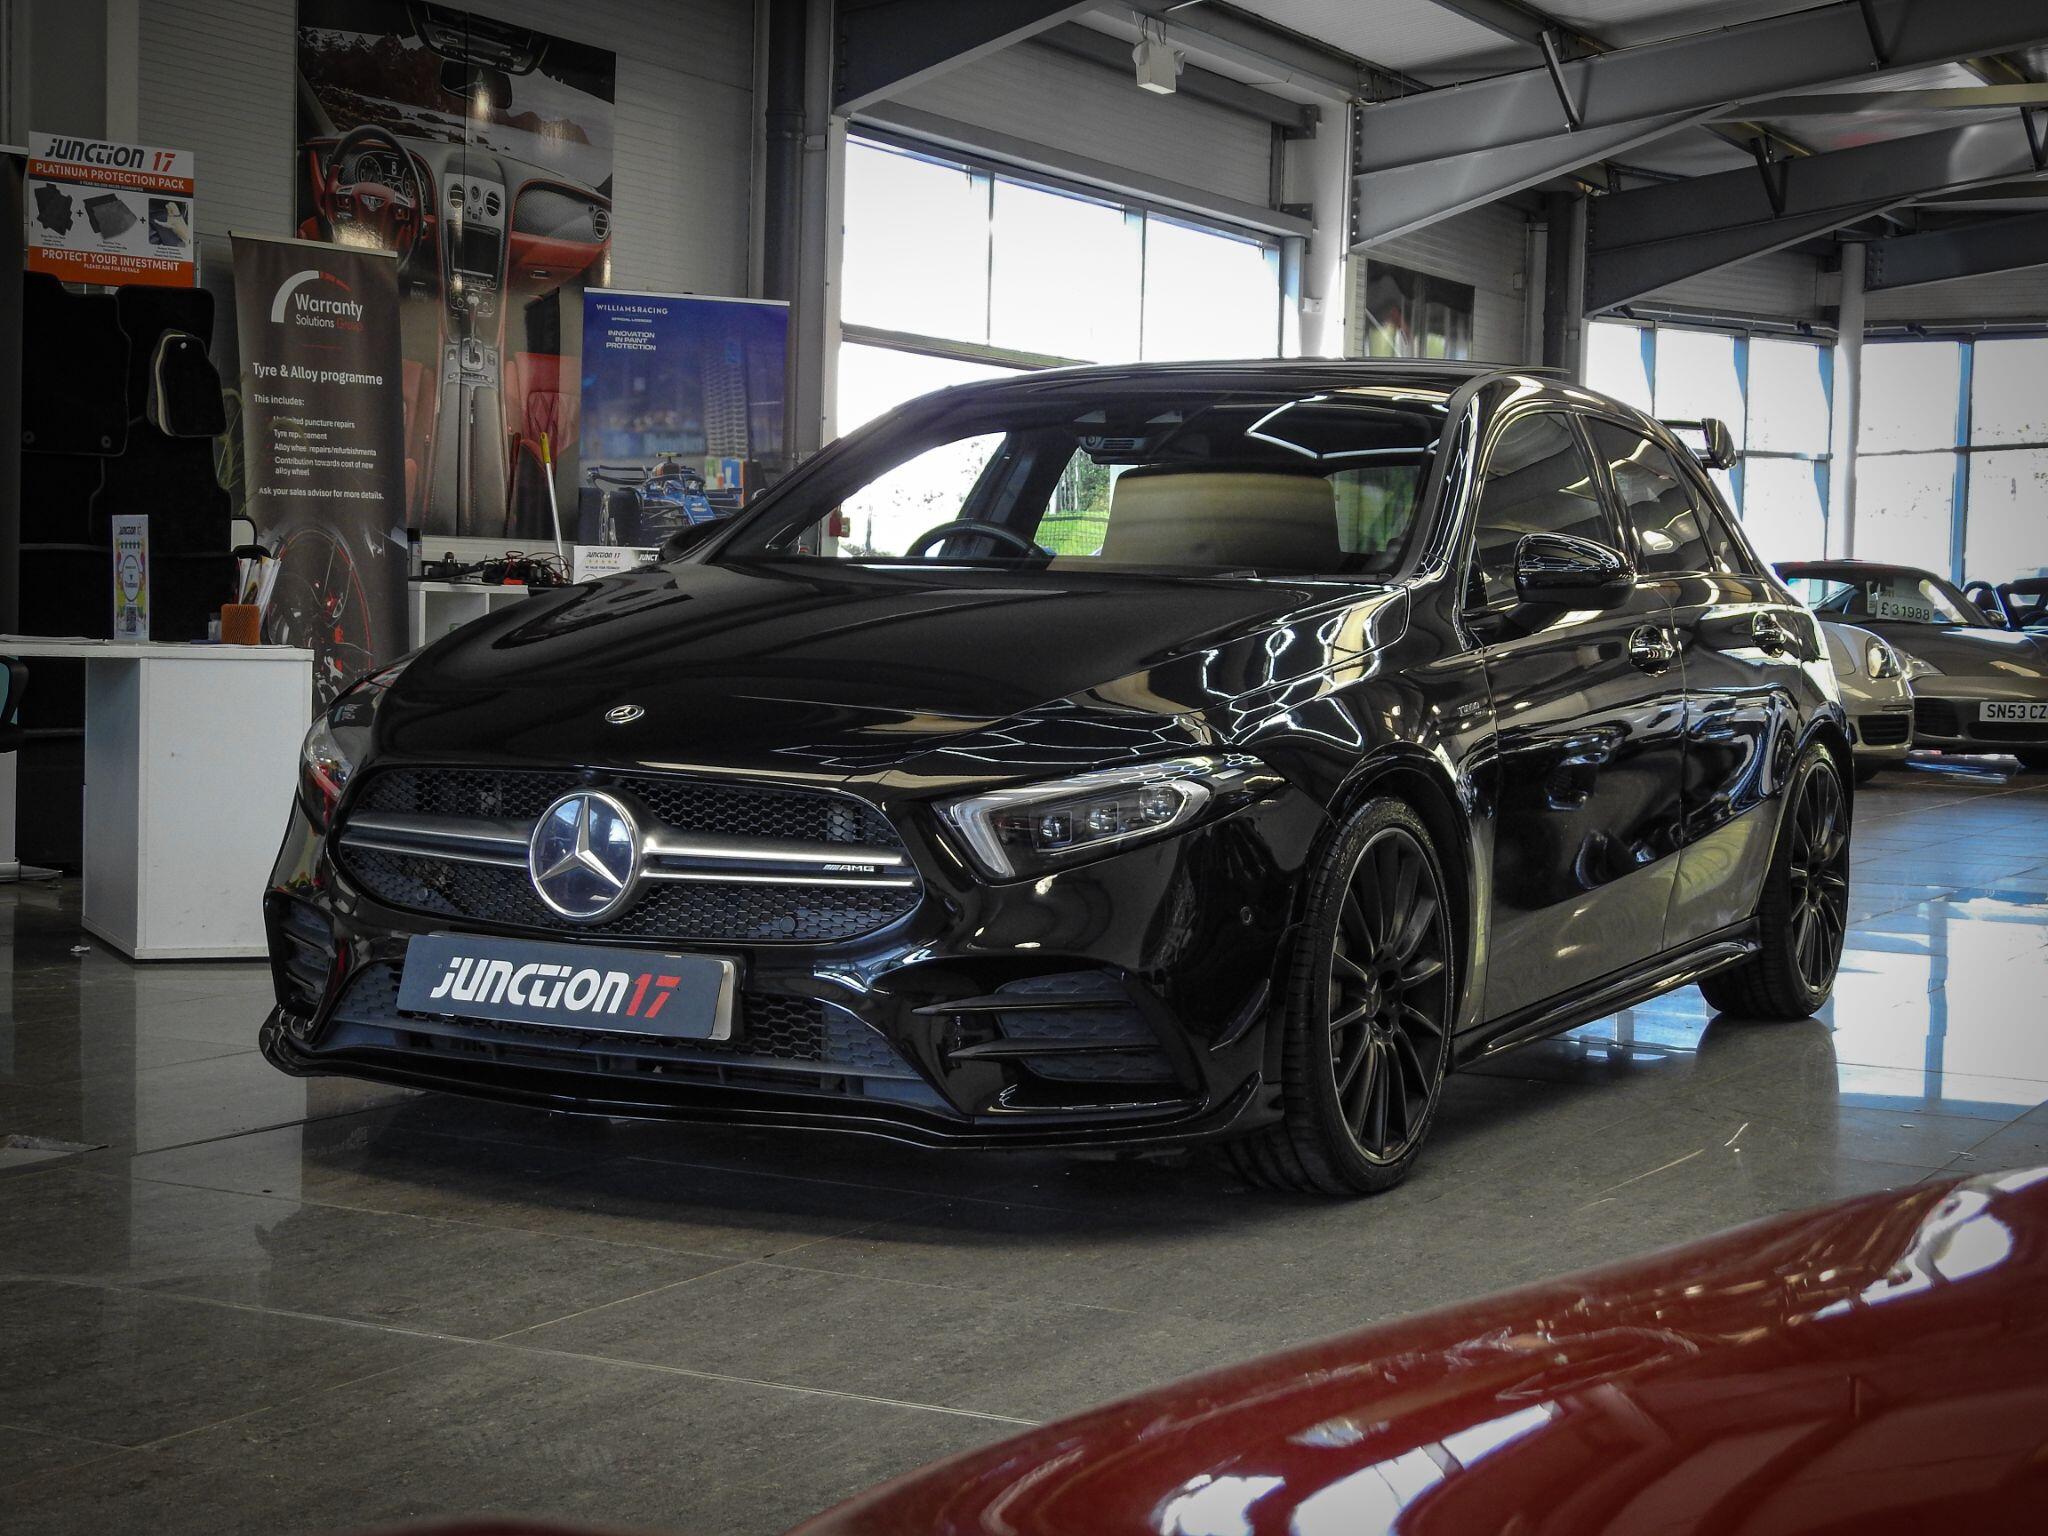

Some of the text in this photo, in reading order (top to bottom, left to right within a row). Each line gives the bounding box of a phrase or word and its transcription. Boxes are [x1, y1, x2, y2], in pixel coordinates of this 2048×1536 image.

[152, 151, 176, 172] 17
[36, 162, 88, 178] PLATINUM
[91, 168, 156, 186] PROTECTION
[158, 178, 185, 190] PACK
[42, 249, 180, 272] PROTECT YOUR INVESTMENT
[295, 293, 363, 321] Warranty
[296, 314, 335, 328] Solutions
[607, 330, 656, 338] INNOVATION
[606, 342, 657, 351] PROTECTION
[253, 362, 383, 385] Tyre & Alloy programme
[254, 394, 305, 406] This includes:
[304, 419, 333, 428] puncture
[334, 420, 356, 429] repairs
[273, 429, 288, 439] Tyre
[274, 443, 291, 453] Alloy
[274, 456, 314, 466] Contribution
[314, 459, 340, 468] towards
[340, 461, 355, 469] cost
[354, 461, 361, 469] of
[275, 467, 310, 477] alloy wheel
[272, 488, 289, 497] your
[289, 488, 307, 497] sales
[307, 489, 333, 499] advisor
[333, 489, 344, 499] for
[343, 491, 361, 499] more
[361, 491, 385, 501] details.
[1986, 704, 2026, 720] SN53
[625, 973, 681, 1018] 17
